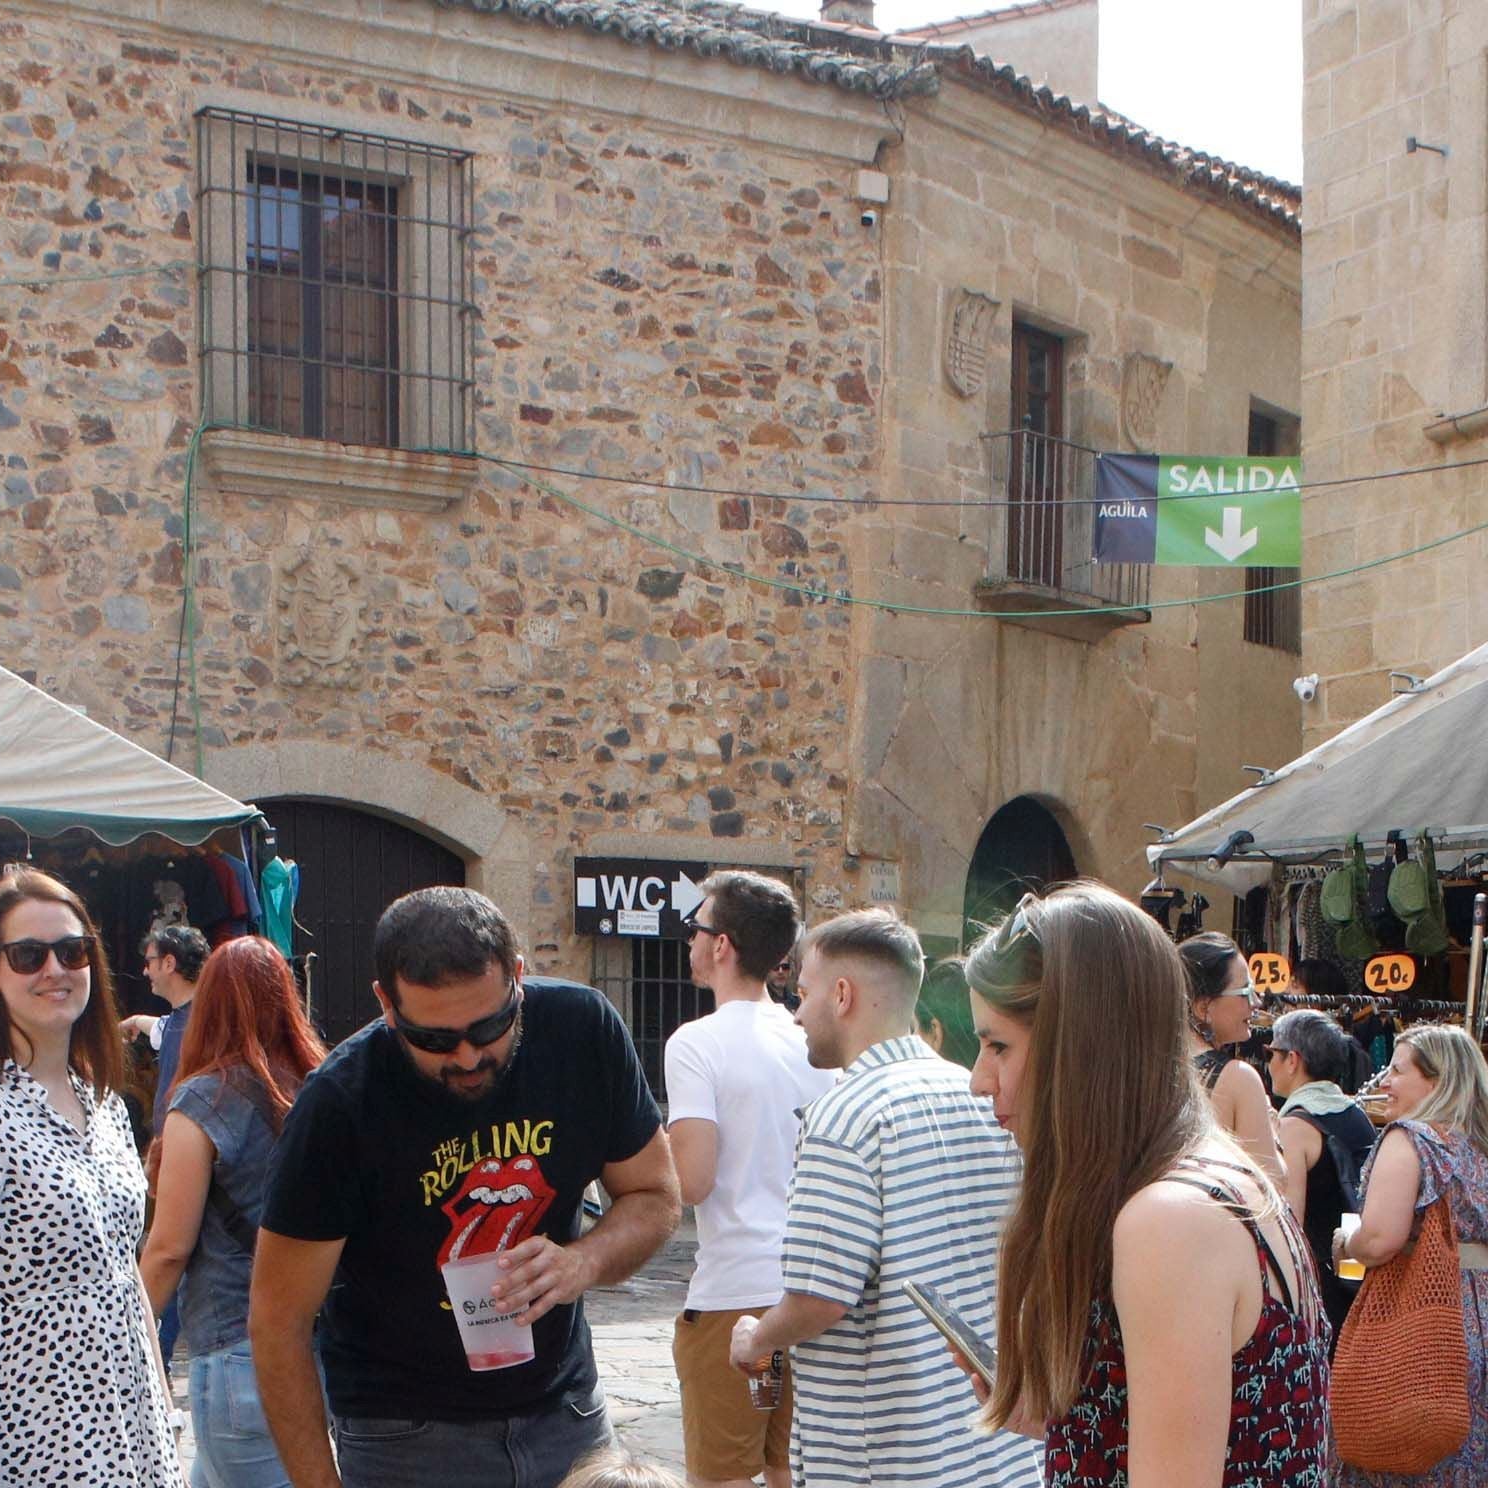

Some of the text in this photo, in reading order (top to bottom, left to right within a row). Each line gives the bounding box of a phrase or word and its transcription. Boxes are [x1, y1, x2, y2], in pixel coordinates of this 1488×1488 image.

[1169, 464, 1300, 493] SALIDA
[599, 874, 666, 912] WC
[419, 1119, 554, 1206] ROLLING
[432, 1137, 461, 1168] THE
